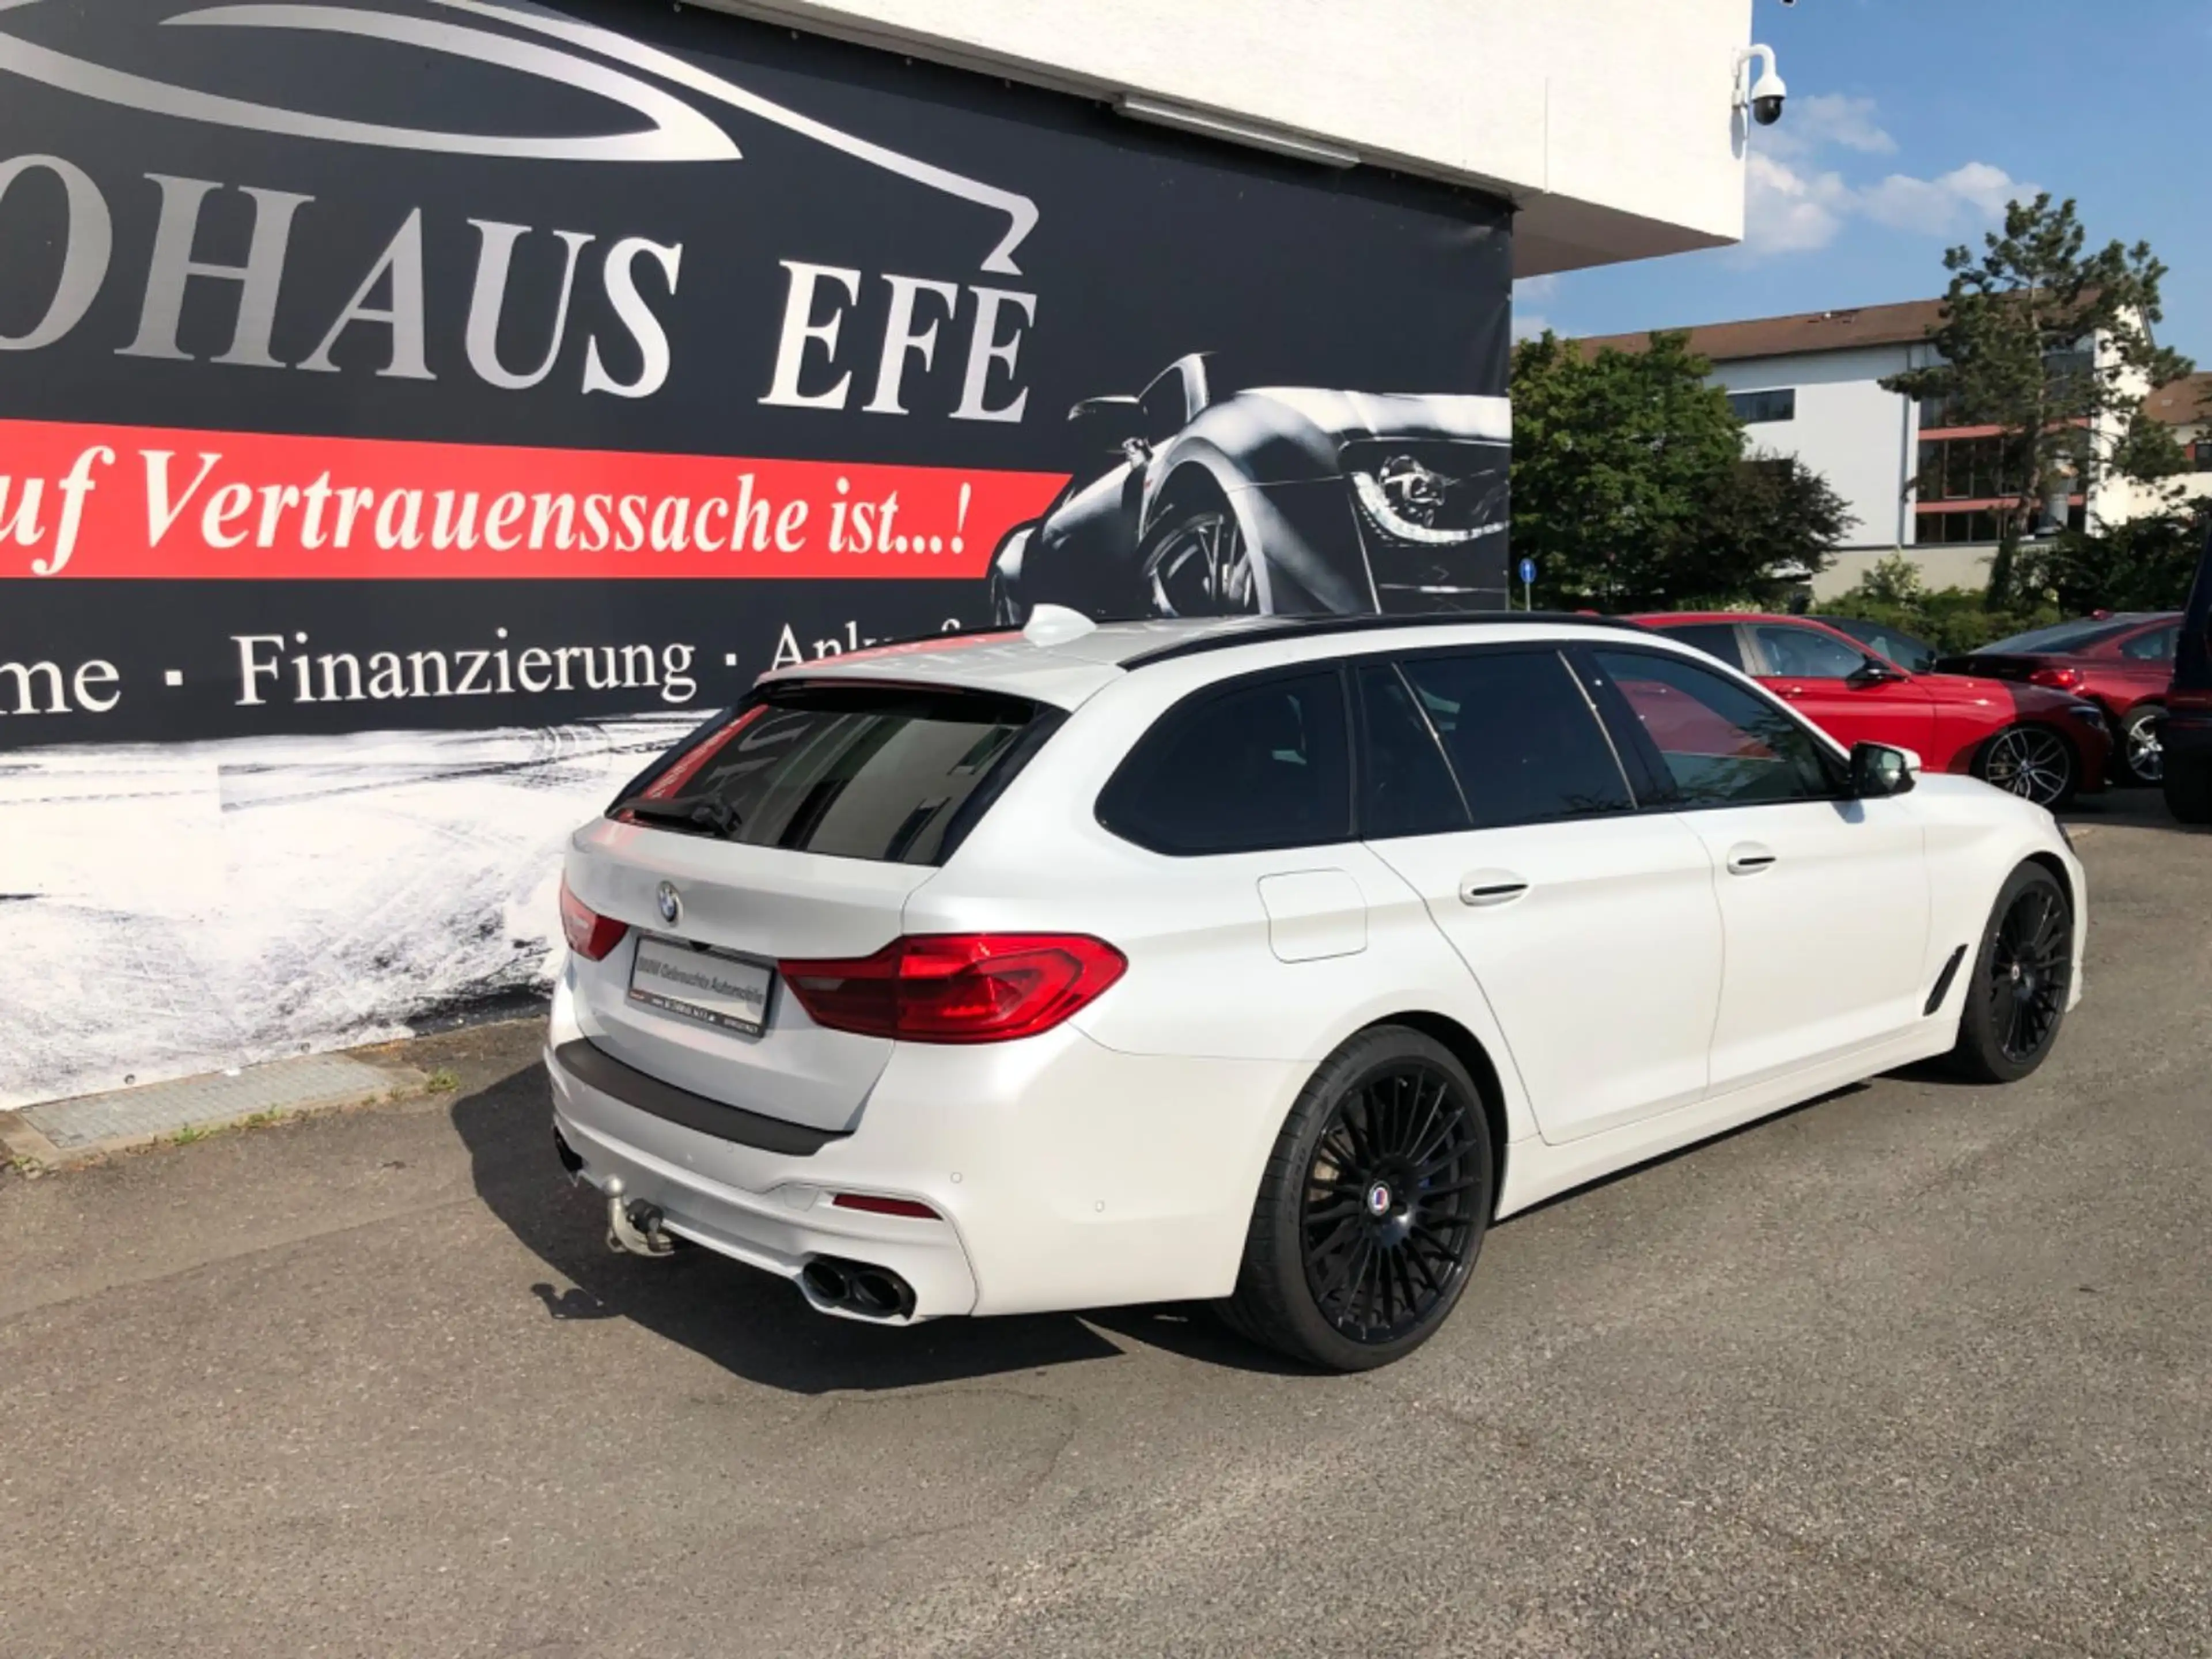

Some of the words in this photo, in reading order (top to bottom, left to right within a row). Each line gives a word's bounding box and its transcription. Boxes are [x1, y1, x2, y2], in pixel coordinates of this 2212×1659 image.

[757, 259, 1037, 423] EFE
[0, 445, 115, 575] uf
[138, 449, 808, 552] Vertrauenssache
[828, 478, 971, 554] ist...!
[230, 627, 696, 705] Finanzierung
